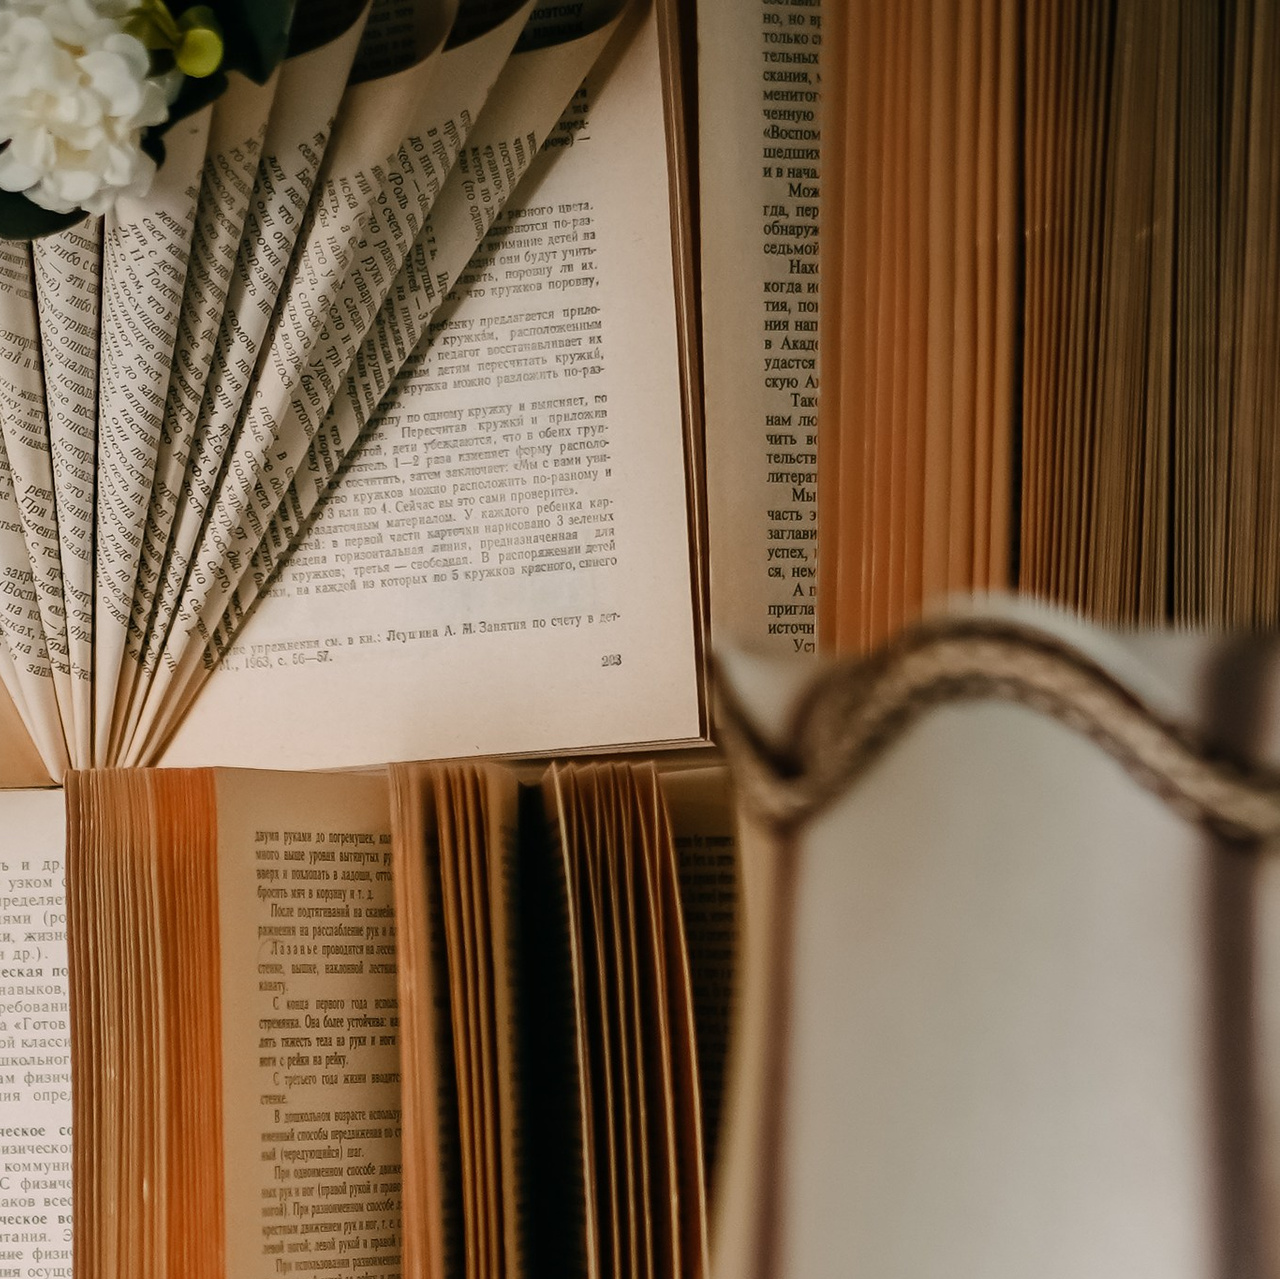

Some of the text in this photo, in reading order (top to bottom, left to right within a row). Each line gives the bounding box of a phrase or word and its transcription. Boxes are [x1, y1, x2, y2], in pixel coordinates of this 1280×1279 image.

[763, 109, 814, 124] ченную
[589, 335, 602, 344] их
[564, 365, 605, 378] по-раз-
[764, 358, 816, 372] удастся
[394, 454, 419, 469] 1—2
[589, 498, 613, 510] кар-
[557, 513, 614, 526] 3 зеленых
[362, 567, 515, 589] из которых 5 кружков
